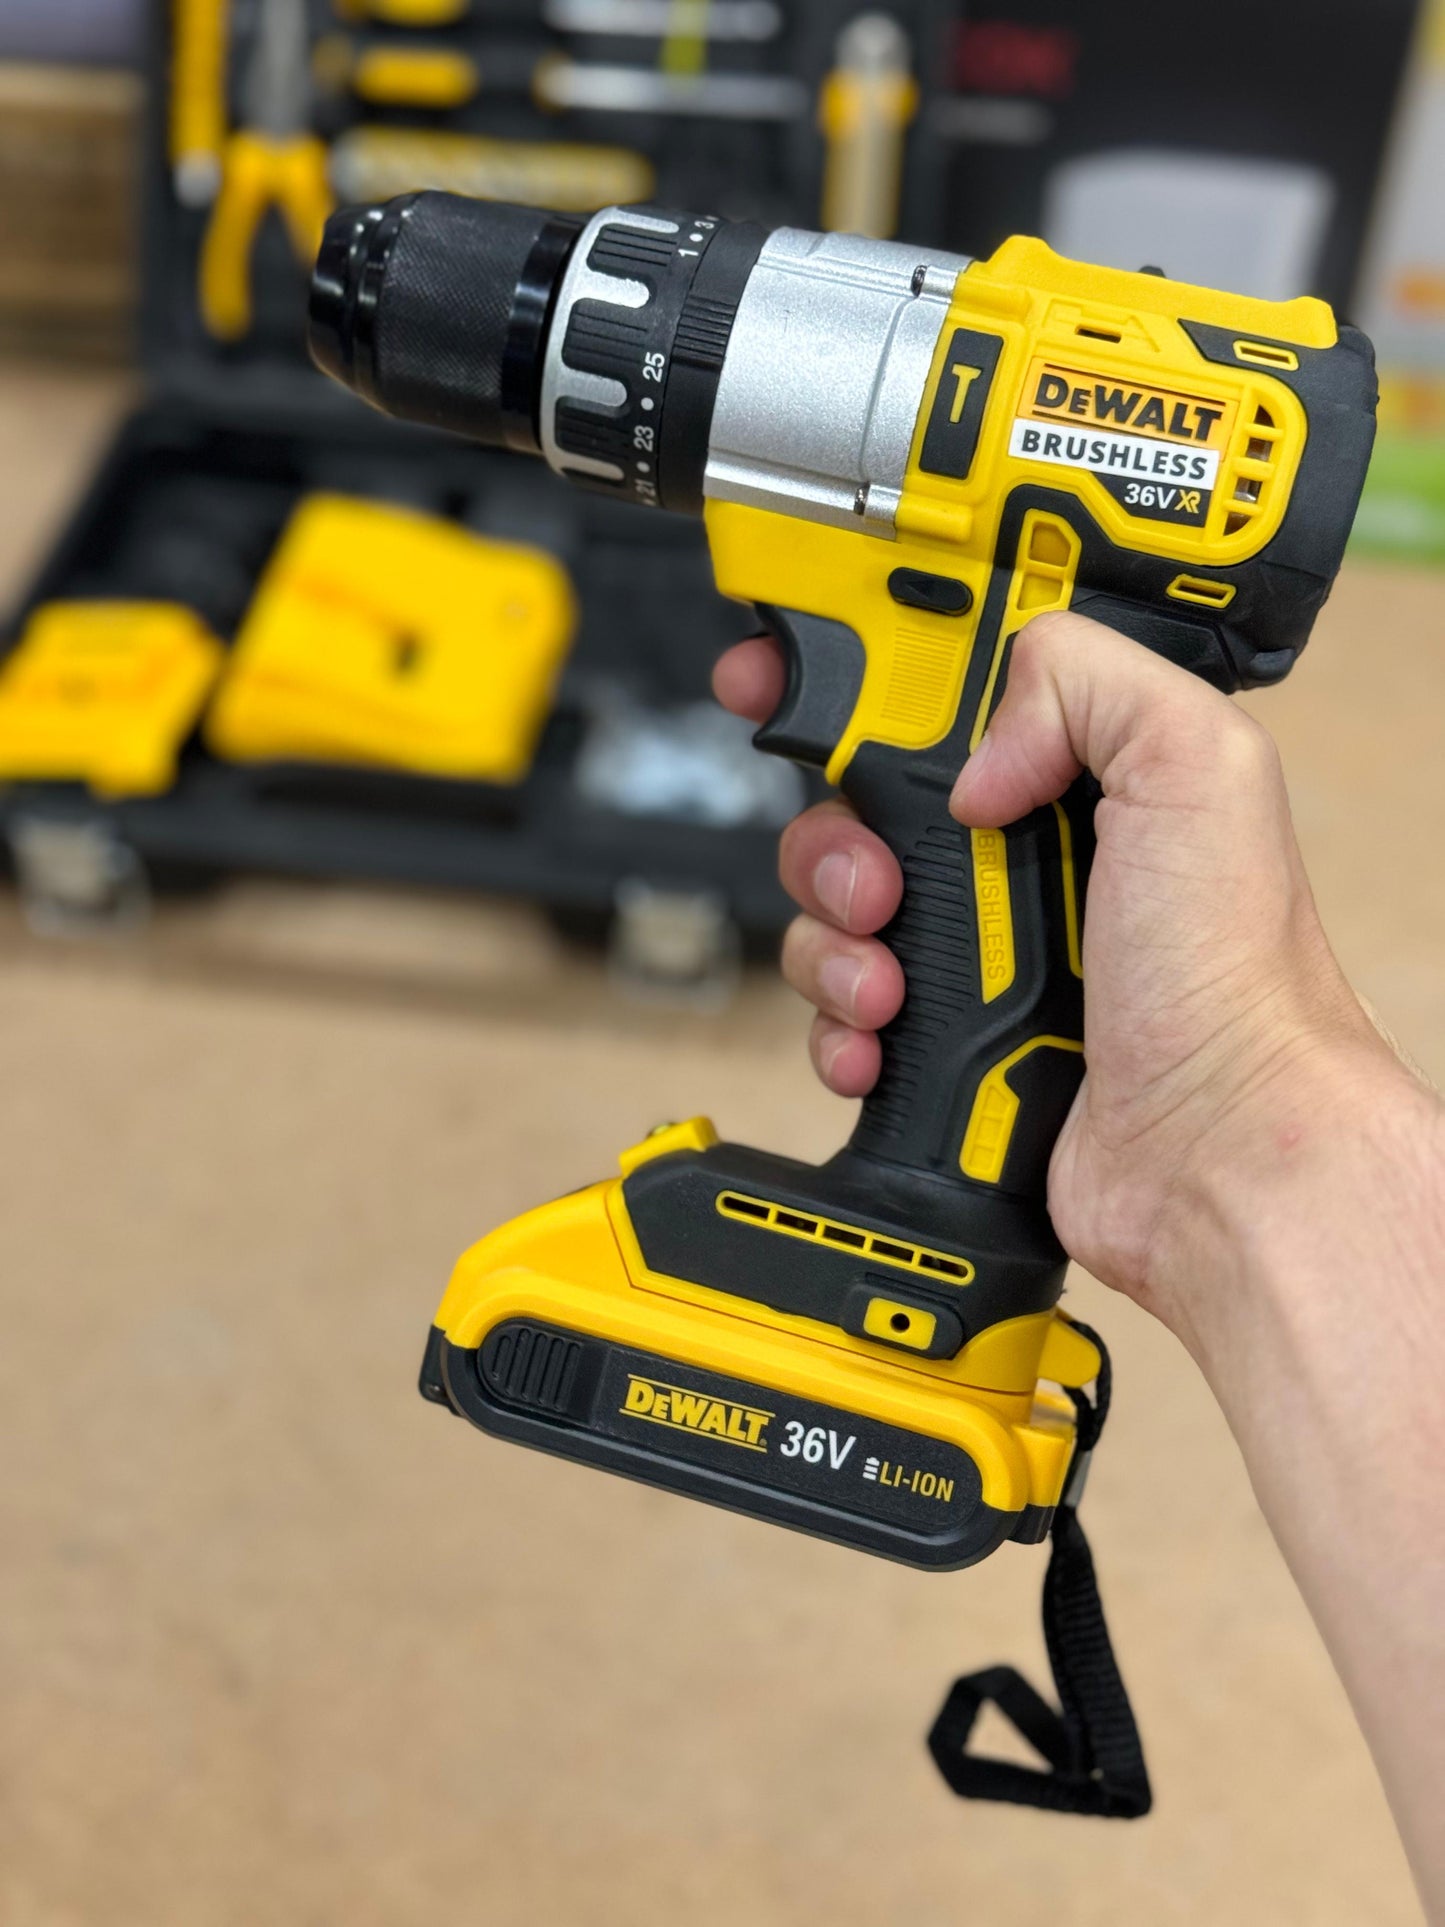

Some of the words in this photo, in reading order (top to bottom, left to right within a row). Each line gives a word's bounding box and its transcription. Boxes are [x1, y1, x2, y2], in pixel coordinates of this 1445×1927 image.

[678, 248, 699, 257] 1
[642, 352, 666, 383] 25
[633, 425, 655, 452] 23
[1021, 429, 1209, 481] BRUSHLESS
[635, 478, 656, 497] 21
[1123, 482, 1176, 510] 36V
[977, 833, 1007, 981] BRUSHLESS
[780, 1420, 857, 1471] 36V
[879, 1460, 955, 1503] LI-ION
